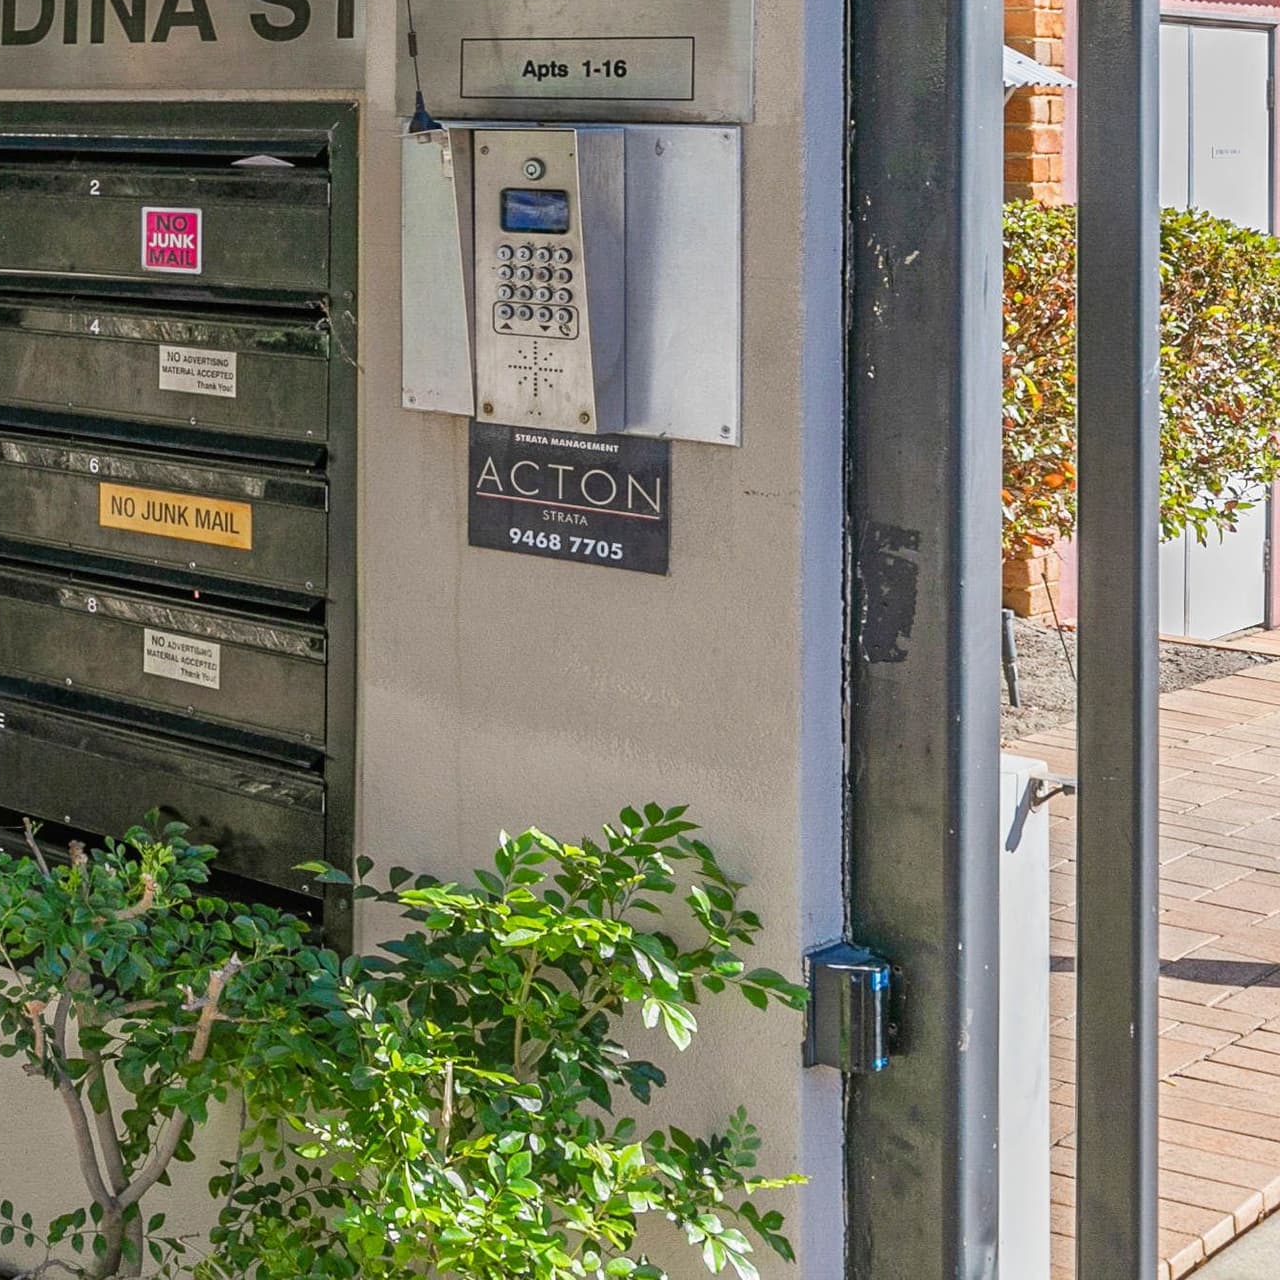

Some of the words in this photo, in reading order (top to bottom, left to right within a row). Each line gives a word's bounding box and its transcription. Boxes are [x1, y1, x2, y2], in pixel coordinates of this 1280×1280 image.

[522, 60, 569, 81] Apts
[582, 60, 627, 78] 1-16
[89, 180, 100, 196] 2
[156, 215, 188, 233] NO
[148, 232, 195, 250] JUNK
[149, 249, 194, 267] MAIL
[90, 319, 100, 335] 4
[167, 351, 181, 363] NO
[161, 364, 196, 377] MATERIAL
[196, 368, 234, 380] ACCEPTED
[197, 379, 217, 391] Thank
[515, 433, 547, 445] STRATA
[551, 438, 619, 452] MANAGEMENT
[89, 457, 99, 472] 6
[476, 456, 661, 513] ACTON
[111, 495, 136, 517] NO
[141, 500, 189, 525] JUNK
[195, 507, 240, 534] MAIL
[542, 509, 589, 526] STRATA
[508, 527, 562, 551] 9468
[568, 537, 624, 560] 7705
[87, 597, 97, 613] 8
[151, 635, 165, 648] NO
[146, 648, 179, 663] MATERIAL
[181, 656, 217, 670] ACCEPTED
